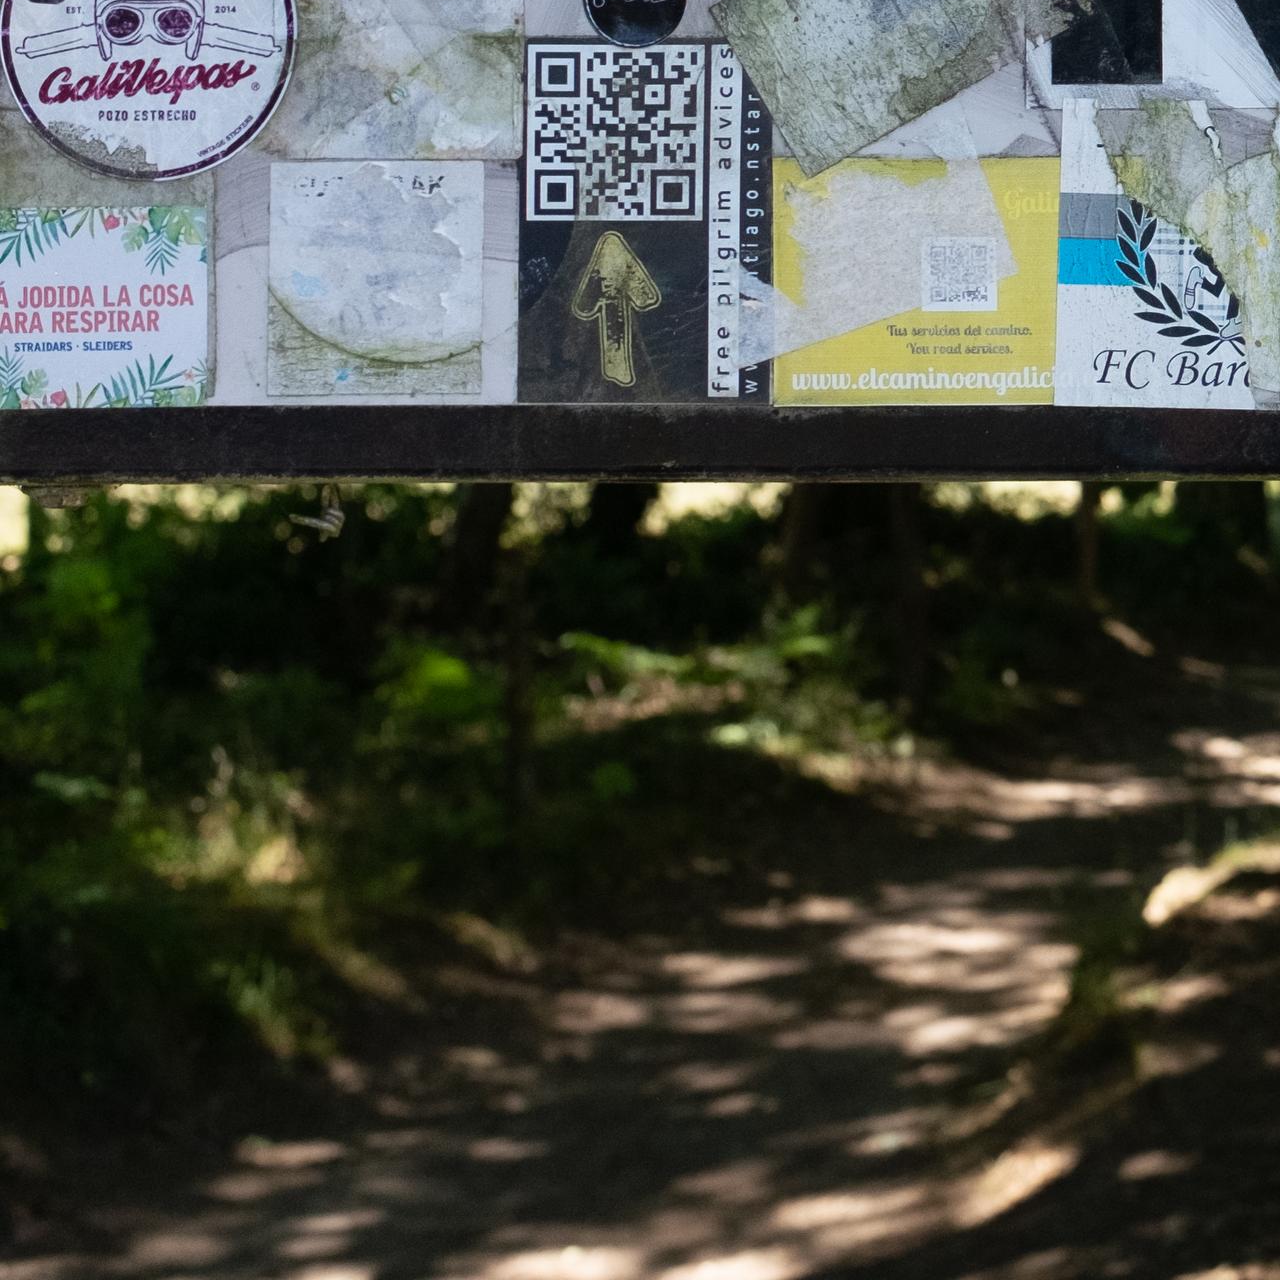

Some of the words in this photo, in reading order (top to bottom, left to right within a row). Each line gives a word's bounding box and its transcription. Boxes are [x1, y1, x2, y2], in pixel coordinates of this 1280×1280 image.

[214, 5, 237, 14] 2014
[98, 109, 129, 121] POZO
[133, 109, 197, 121] ESTRECHO
[714, 47, 734, 170] advices
[712, 190, 738, 306] pilgrim
[17, 285, 95, 309] JODIDA
[102, 284, 132, 308] LA
[139, 283, 195, 307] COSA
[51, 310, 160, 334] RESPIRAR
[887, 324, 908, 337] Tus
[912, 325, 961, 337] servicios
[964, 325, 982, 337] del
[14, 341, 73, 353] STRAIDARS
[83, 340, 133, 352] SLEIDERS
[907, 342, 930, 355] You
[933, 342, 962, 355] road
[965, 344, 1014, 355] services.
[712, 327, 730, 394] free
[1093, 349, 1156, 390] FC
